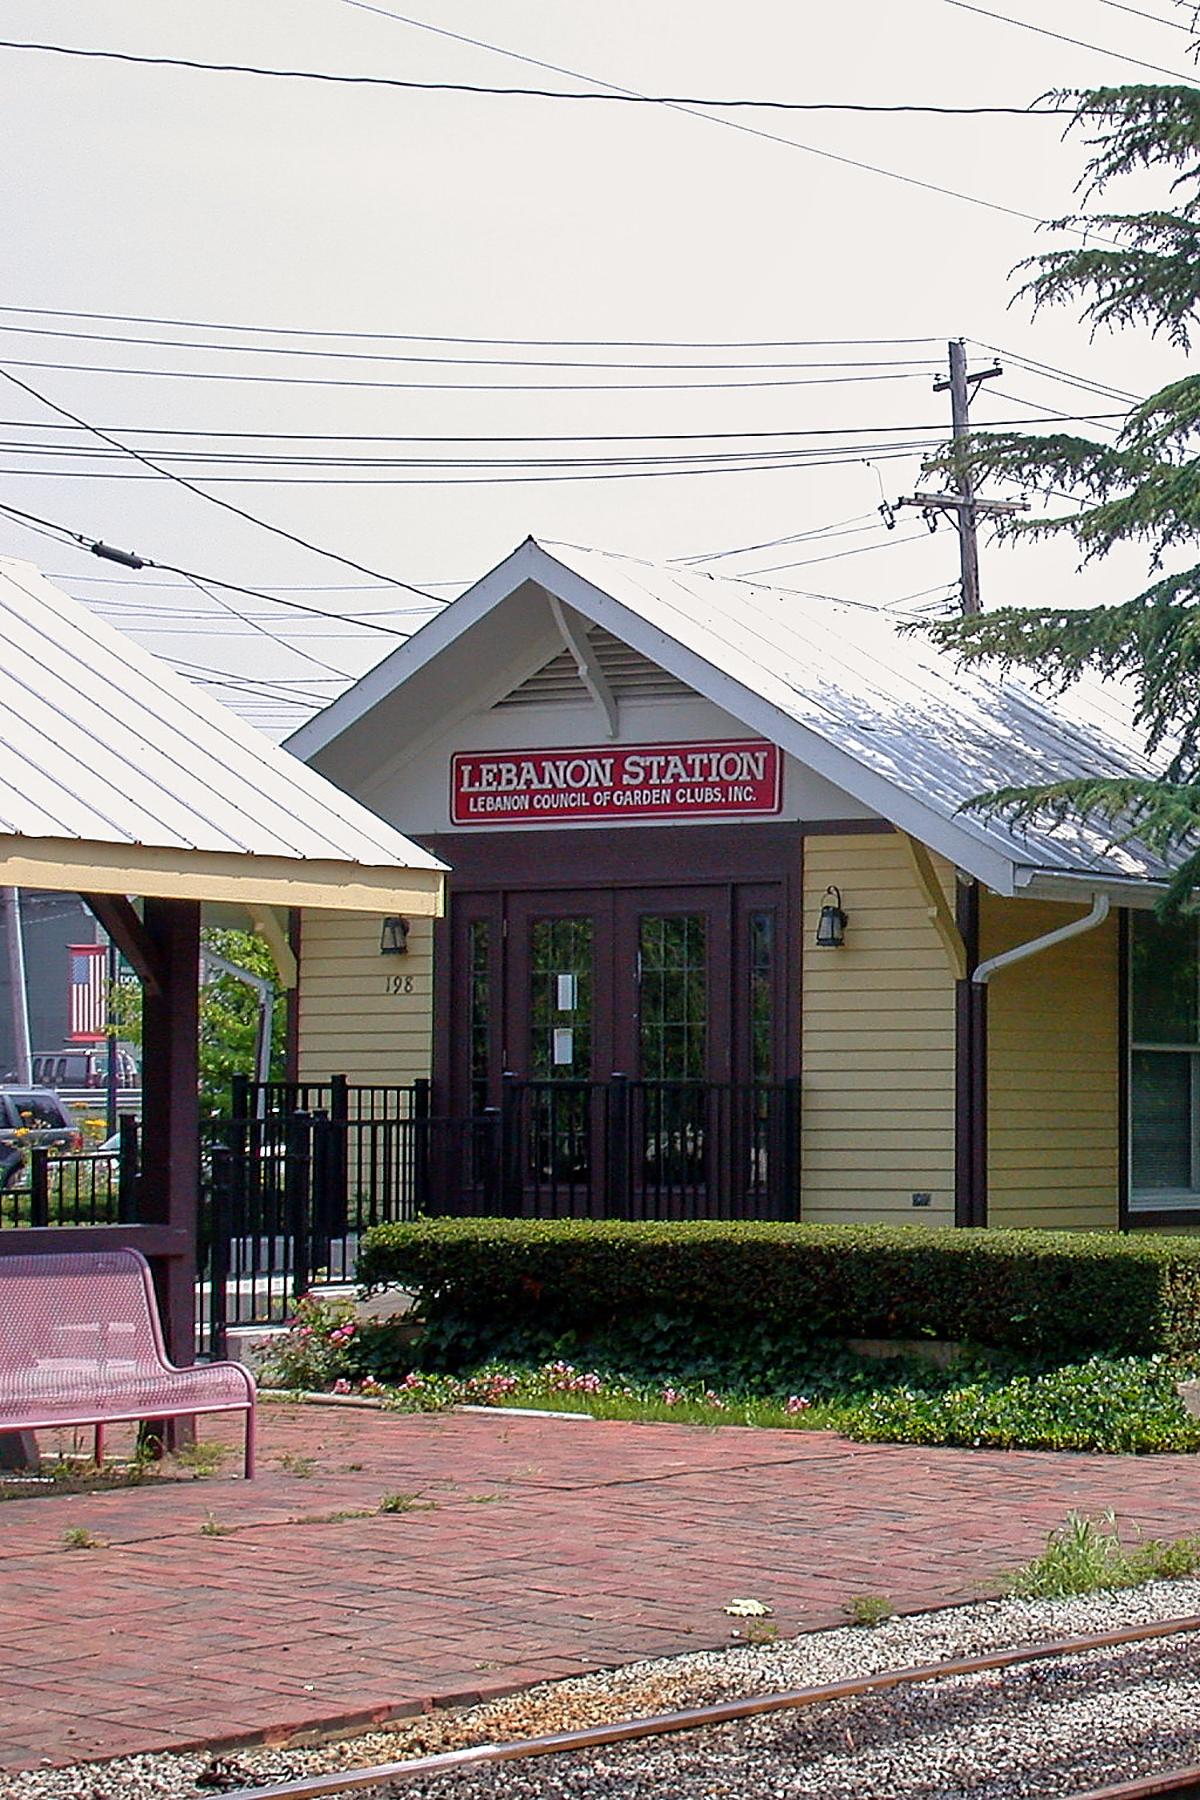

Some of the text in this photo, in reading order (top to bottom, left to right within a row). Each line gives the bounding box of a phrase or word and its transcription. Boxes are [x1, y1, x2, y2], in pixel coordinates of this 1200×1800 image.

[460, 751, 768, 792] LEBANON STATION
[469, 795, 530, 812] LEBANON
[533, 792, 590, 809] COUNCIL
[593, 791, 611, 807] OF
[613, 789, 671, 806] GARDEN
[728, 786, 757, 802] INC.
[386, 975, 414, 994] 198
